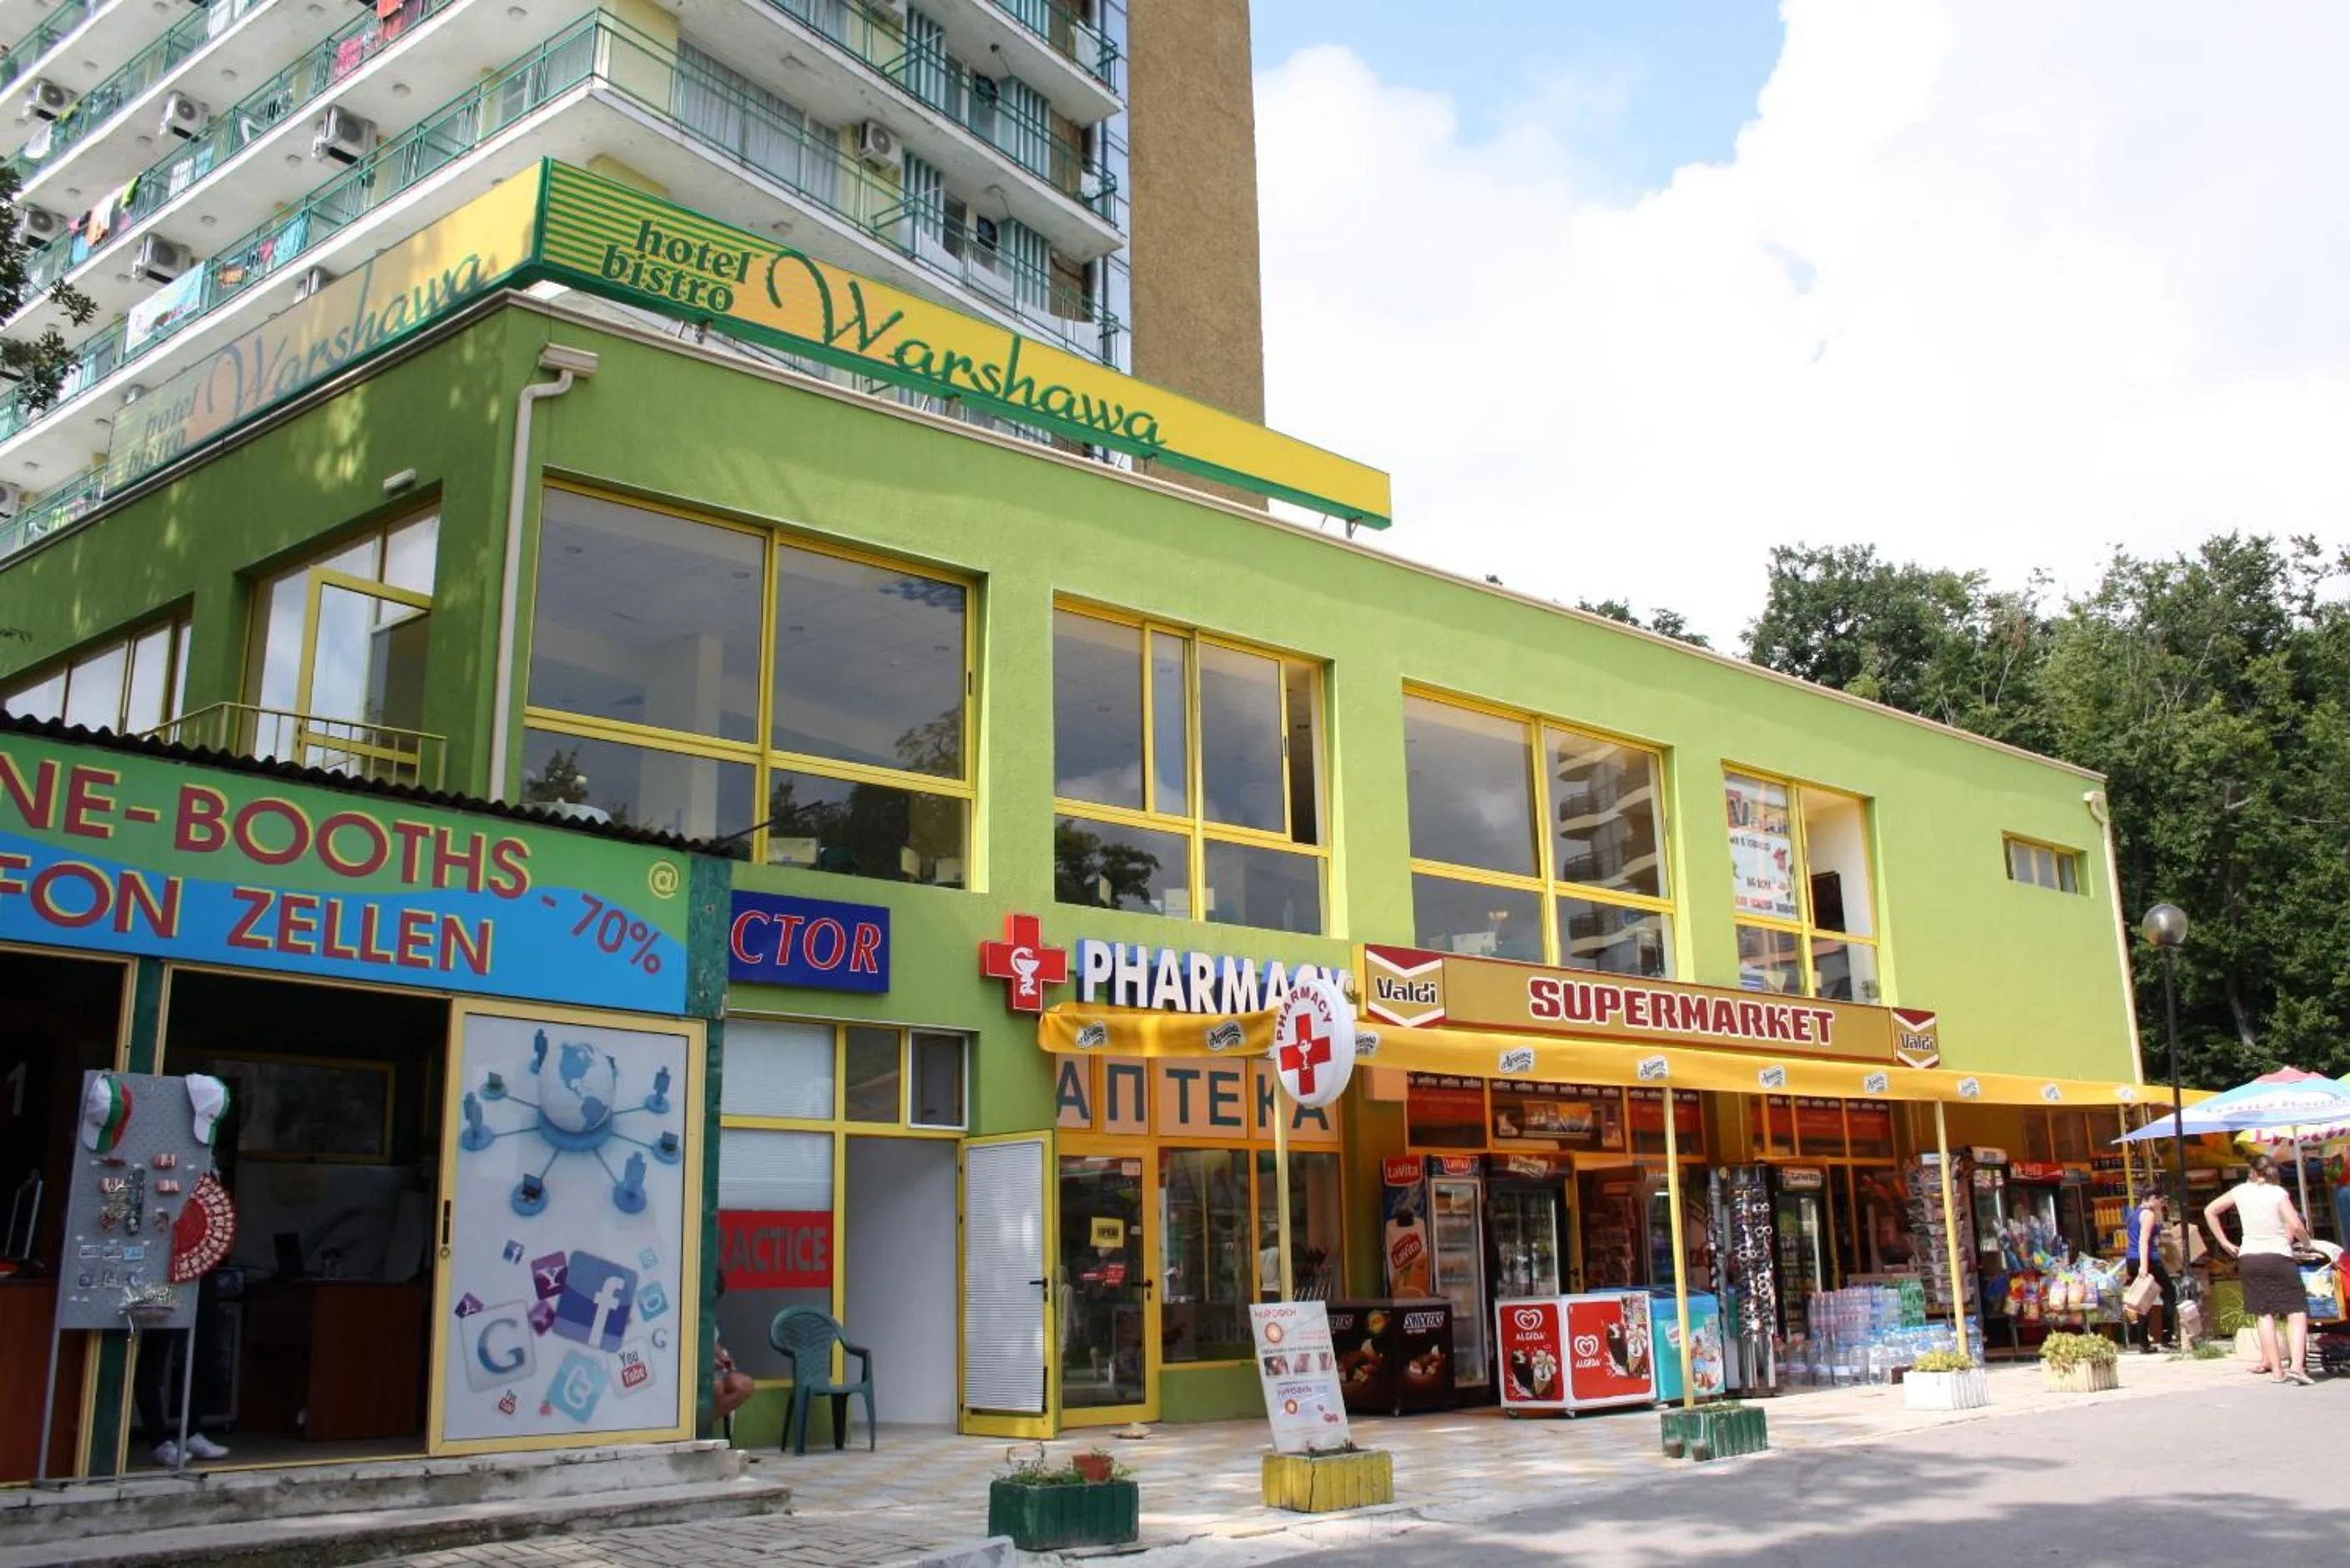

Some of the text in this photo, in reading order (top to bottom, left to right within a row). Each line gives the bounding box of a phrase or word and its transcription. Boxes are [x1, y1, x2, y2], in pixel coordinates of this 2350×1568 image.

[601, 243, 734, 313] bistro
[636, 219, 752, 284] hotel
[207, 253, 489, 418] Warshawa
[767, 250, 1166, 446] Warshawa
[227, 885, 493, 976] ZELLEN
[730, 909, 882, 974] CTOR
[1276, 986, 1334, 1041] PHARMACY
[1376, 976, 1835, 1044] Valdi SUPERMARKET
[1899, 1033, 1934, 1052] Valdi
[477, 1318, 526, 1374] G
[618, 1350, 638, 1366] You
[1515, 1331, 1546, 1342] ALGIDA
